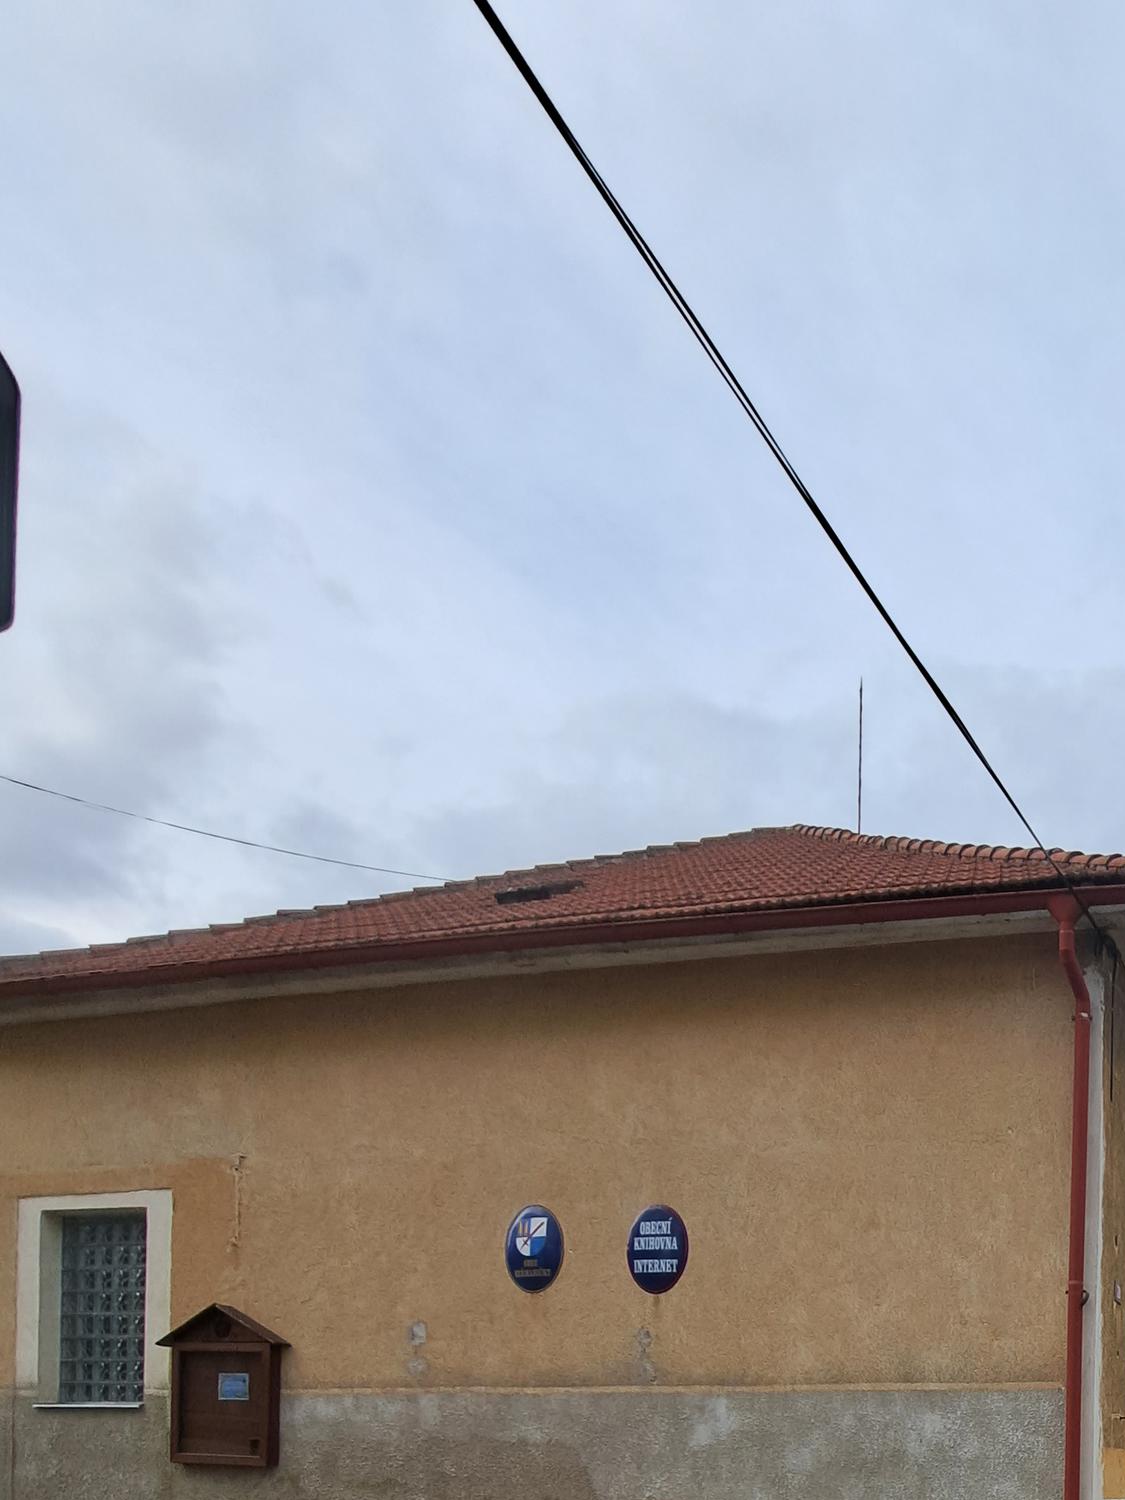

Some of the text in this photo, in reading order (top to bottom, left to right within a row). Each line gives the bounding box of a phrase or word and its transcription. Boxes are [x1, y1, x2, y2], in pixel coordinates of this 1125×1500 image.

[639, 1217, 672, 1235] OBECNÍ
[633, 1237, 678, 1250] KNIHOVNA
[633, 1259, 678, 1273] INTERNET
